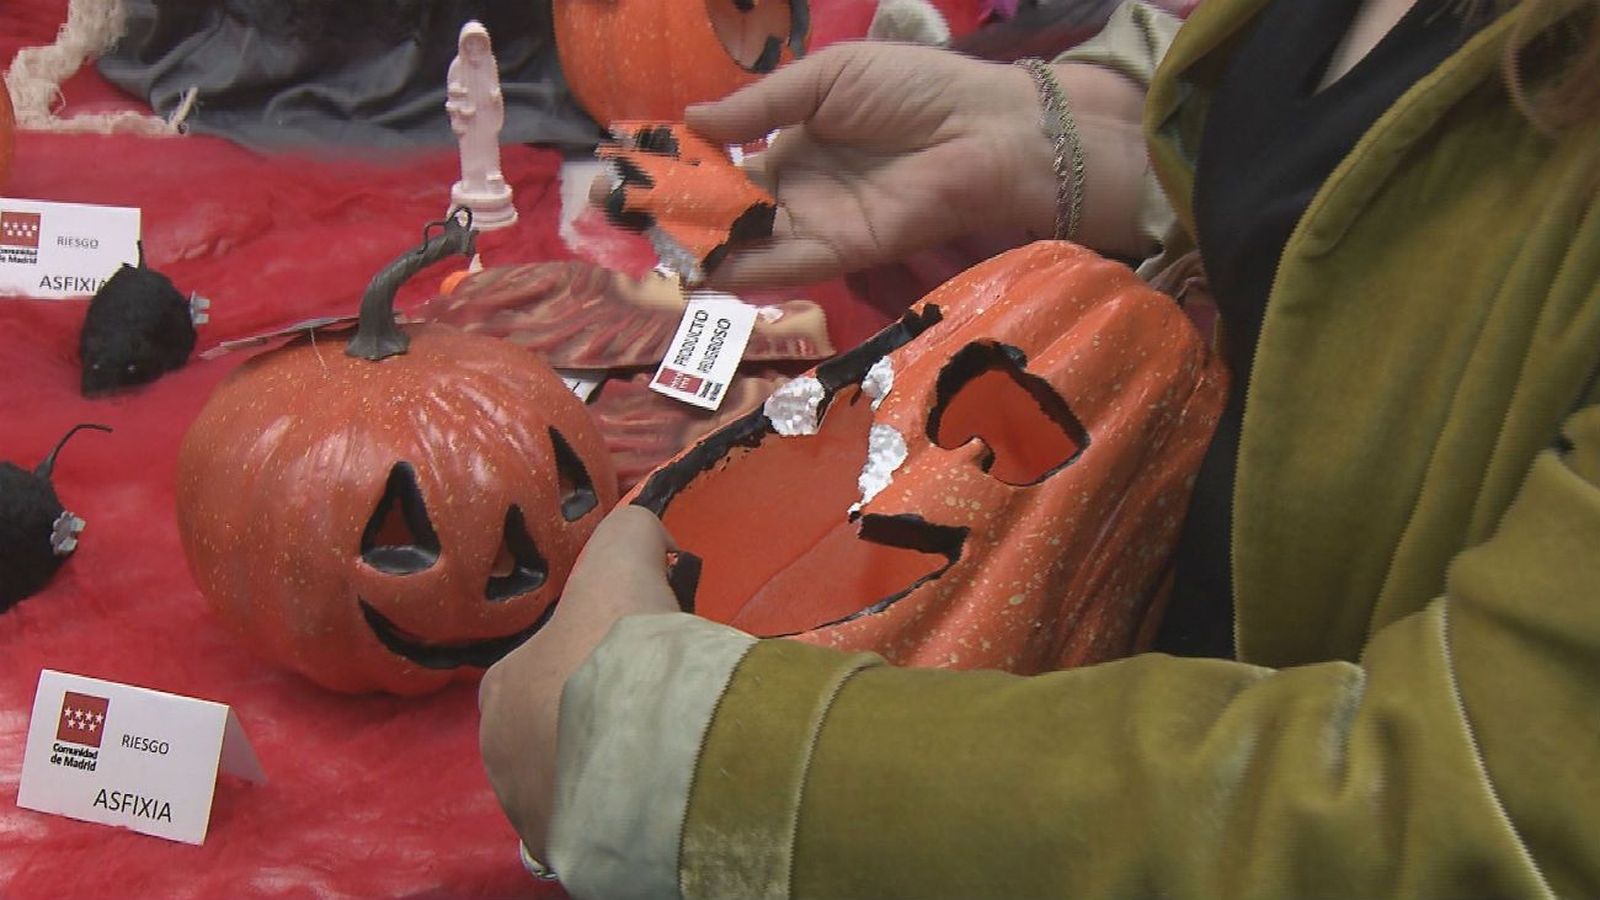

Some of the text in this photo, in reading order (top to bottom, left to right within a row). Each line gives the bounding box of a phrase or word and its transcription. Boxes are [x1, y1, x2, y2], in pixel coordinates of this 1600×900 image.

[57, 236, 99, 249] RIESGO
[52, 742, 98, 760] Comunidad
[121, 734, 169, 755] RIESGO
[50, 754, 97, 772] de Madrid
[93, 788, 172, 823] ASFIXIA
